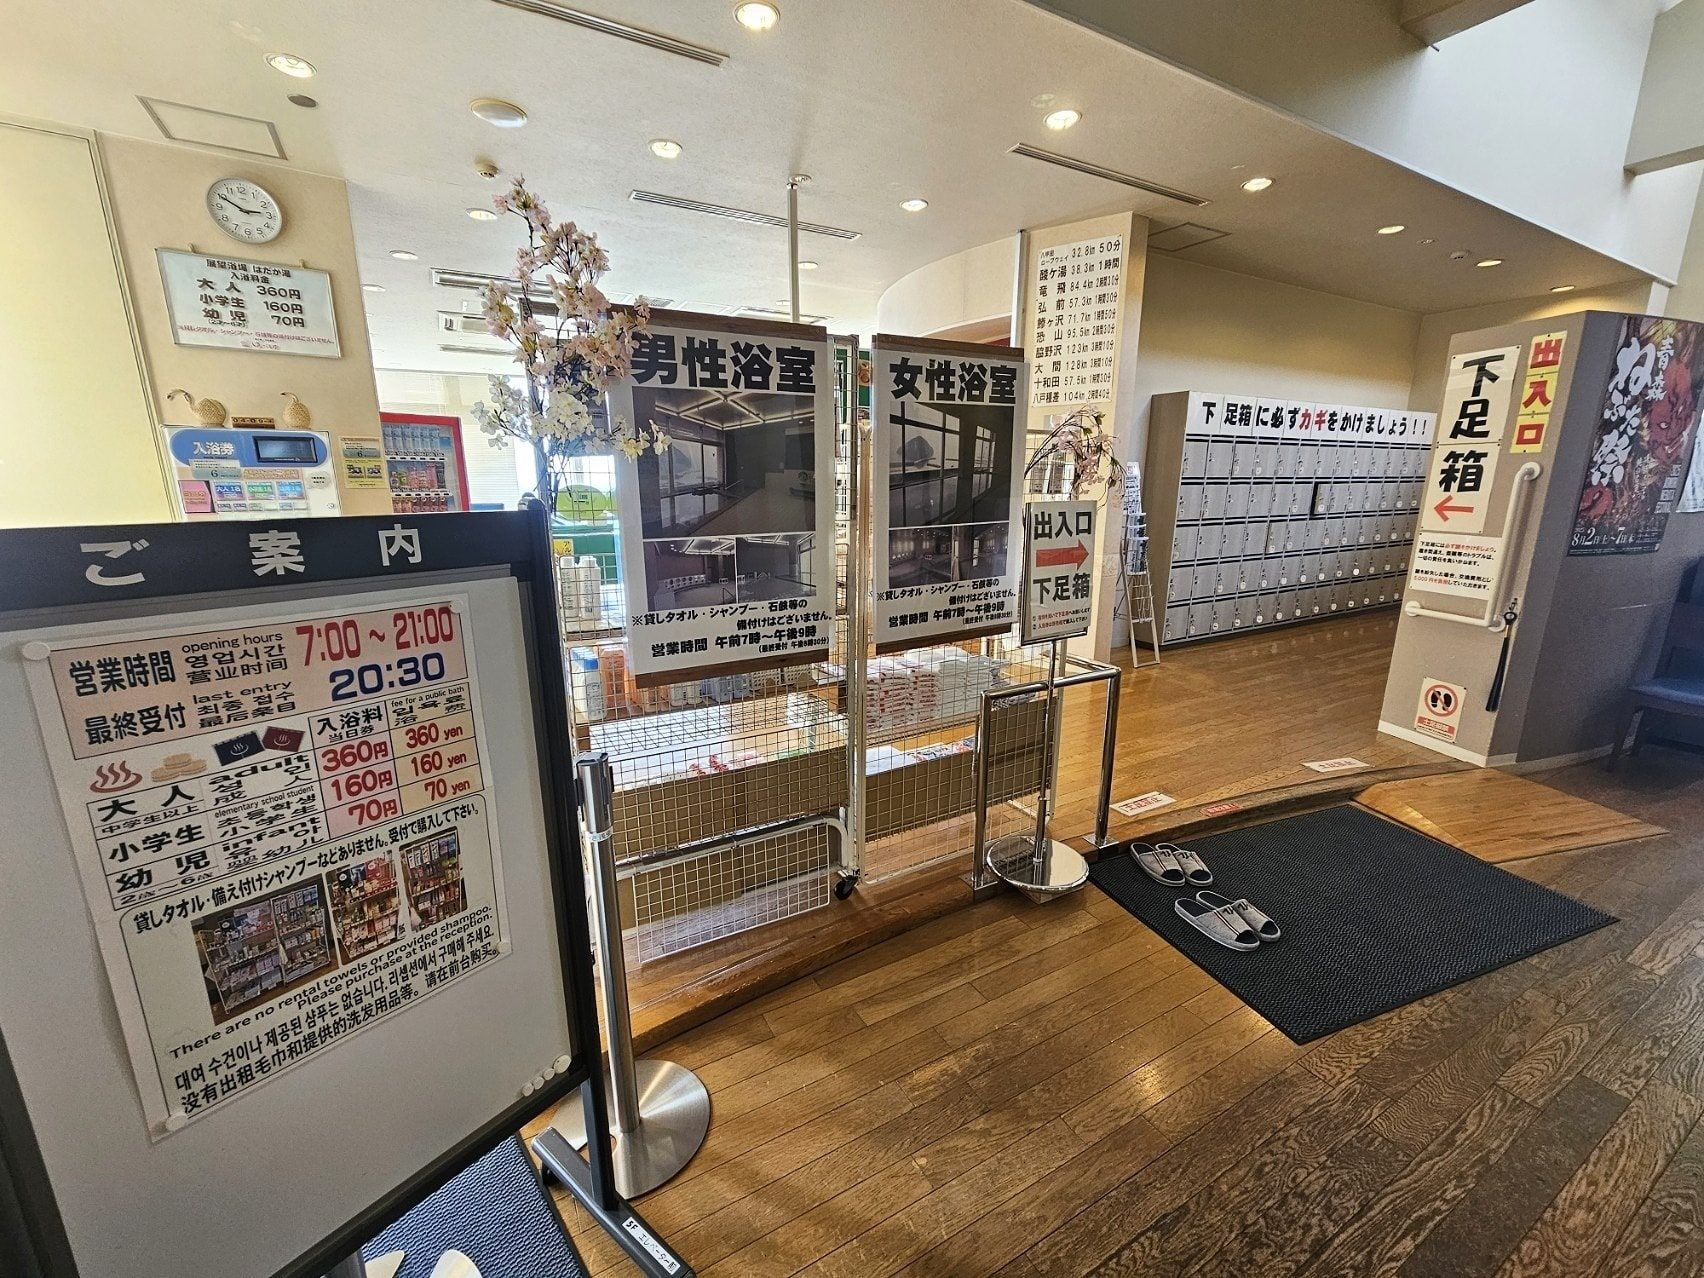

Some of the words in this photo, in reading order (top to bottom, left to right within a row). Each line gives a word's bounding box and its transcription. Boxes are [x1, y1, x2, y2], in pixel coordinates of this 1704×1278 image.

[226, 187, 233, 195] 11
[236, 186, 247, 195] 12
[215, 203, 223, 211] 9
[260, 200, 267, 209] 2
[266, 211, 273, 220] 3
[221, 214, 229, 222] 8
[232, 222, 239, 231] 7
[256, 227, 263, 235] 5
[244, 228, 252, 236] 6
[1071, 245, 1095, 259] 32.8km
[1099, 239, 1121, 254] 50分
[1098, 257, 1120, 271] 1時間
[196, 278, 242, 293] 大人
[256, 285, 302, 300] 360円
[231, 271, 270, 284] 入浴料金
[1038, 281, 1067, 298] 竜飛
[1069, 279, 1094, 292] 84.4km
[199, 293, 246, 308] 小学生
[263, 300, 304, 315] 160円
[1038, 298, 1065, 314] 弘前
[1068, 296, 1092, 309] 57.3km
[271, 315, 305, 328] 70円
[1067, 312, 1091, 325] 71.7km
[1036, 328, 1063, 344] 恐山
[1066, 343, 1089, 354] 123km
[631, 333, 817, 394] 男性浴室
[1034, 360, 1061, 375] 大間
[1065, 359, 1088, 371] 128km
[1645, 335, 1675, 401] 青森
[889, 356, 1018, 405] 女性浴室
[1033, 376, 1060, 389] 十和田
[1515, 337, 1563, 446] 出入口
[1438, 354, 1506, 494] 下足箱
[1591, 337, 1656, 487] ねぶた祭
[193, 441, 235, 455] 入浴券
[1033, 511, 1092, 540] 出入口
[1032, 572, 1091, 605] 下足箱
[888, 611, 929, 628] 営業時間
[181, 636, 240, 654] opening
[243, 632, 283, 646] hours
[296, 619, 361, 666] 7:00
[393, 606, 454, 650] 21:00
[651, 637, 709, 658] 営業時間
[715, 624, 817, 650] 午前7時〜午後9時
[185, 643, 286, 669] 영업시간
[69, 650, 176, 697] 営業時間
[186, 657, 288, 685] 营业时间
[329, 652, 446, 701] 20:30
[193, 690, 234, 705] last
[240, 680, 292, 697] entry
[197, 699, 244, 716] 최종
[252, 690, 295, 706] 접수
[391, 700, 404, 708] fee
[405, 697, 417, 705] for
[425, 689, 447, 701] public
[448, 686, 465, 695] bath
[85, 702, 186, 745] 最終受付
[198, 701, 296, 729] 最后条目
[316, 705, 384, 735] 入浴料
[328, 725, 375, 742] 当日券
[405, 722, 440, 749] 360
[443, 725, 464, 740] yen
[321, 740, 389, 772] 360円
[410, 750, 443, 777] 160
[447, 752, 467, 768] yen
[209, 754, 310, 785] adult
[331, 769, 394, 801] 160円
[424, 778, 447, 801] 70
[451, 778, 471, 796] yen
[97, 784, 196, 822] 大人
[214, 800, 259, 818] elementary
[261, 792, 285, 806] school
[286, 785, 315, 799] student
[348, 799, 399, 826] 70円
[101, 805, 200, 834] 中学生以上
[108, 824, 206, 863] 小学生
[222, 816, 321, 852] infant
[115, 850, 211, 894] 幼児
[296, 983, 343, 1010] Please
[345, 955, 401, 992] purchase
[405, 949, 418, 961] at
[419, 936, 439, 953] the
[439, 913, 494, 944] reception.
[169, 1030, 222, 1060] There
[225, 1018, 251, 1035] are
[254, 1006, 275, 1021] no
[278, 982, 321, 1010] rental
[324, 962, 368, 987] towels
[369, 954, 385, 966] or
[386, 927, 438, 961] provided
[440, 905, 493, 933] shampoo.
[175, 1063, 206, 1092] 대여
[208, 1035, 263, 1077] 수건이나
[264, 1017, 303, 1047] 제공된
[304, 999, 340, 1030] 샴푸는
[341, 977, 389, 1010] 없습니다.
[388, 952, 438, 987] 리셉션에서
[438, 938, 465, 963] 구매해
[466, 924, 495, 949] 주세요.
[625, 1220, 639, 1230] 5F
